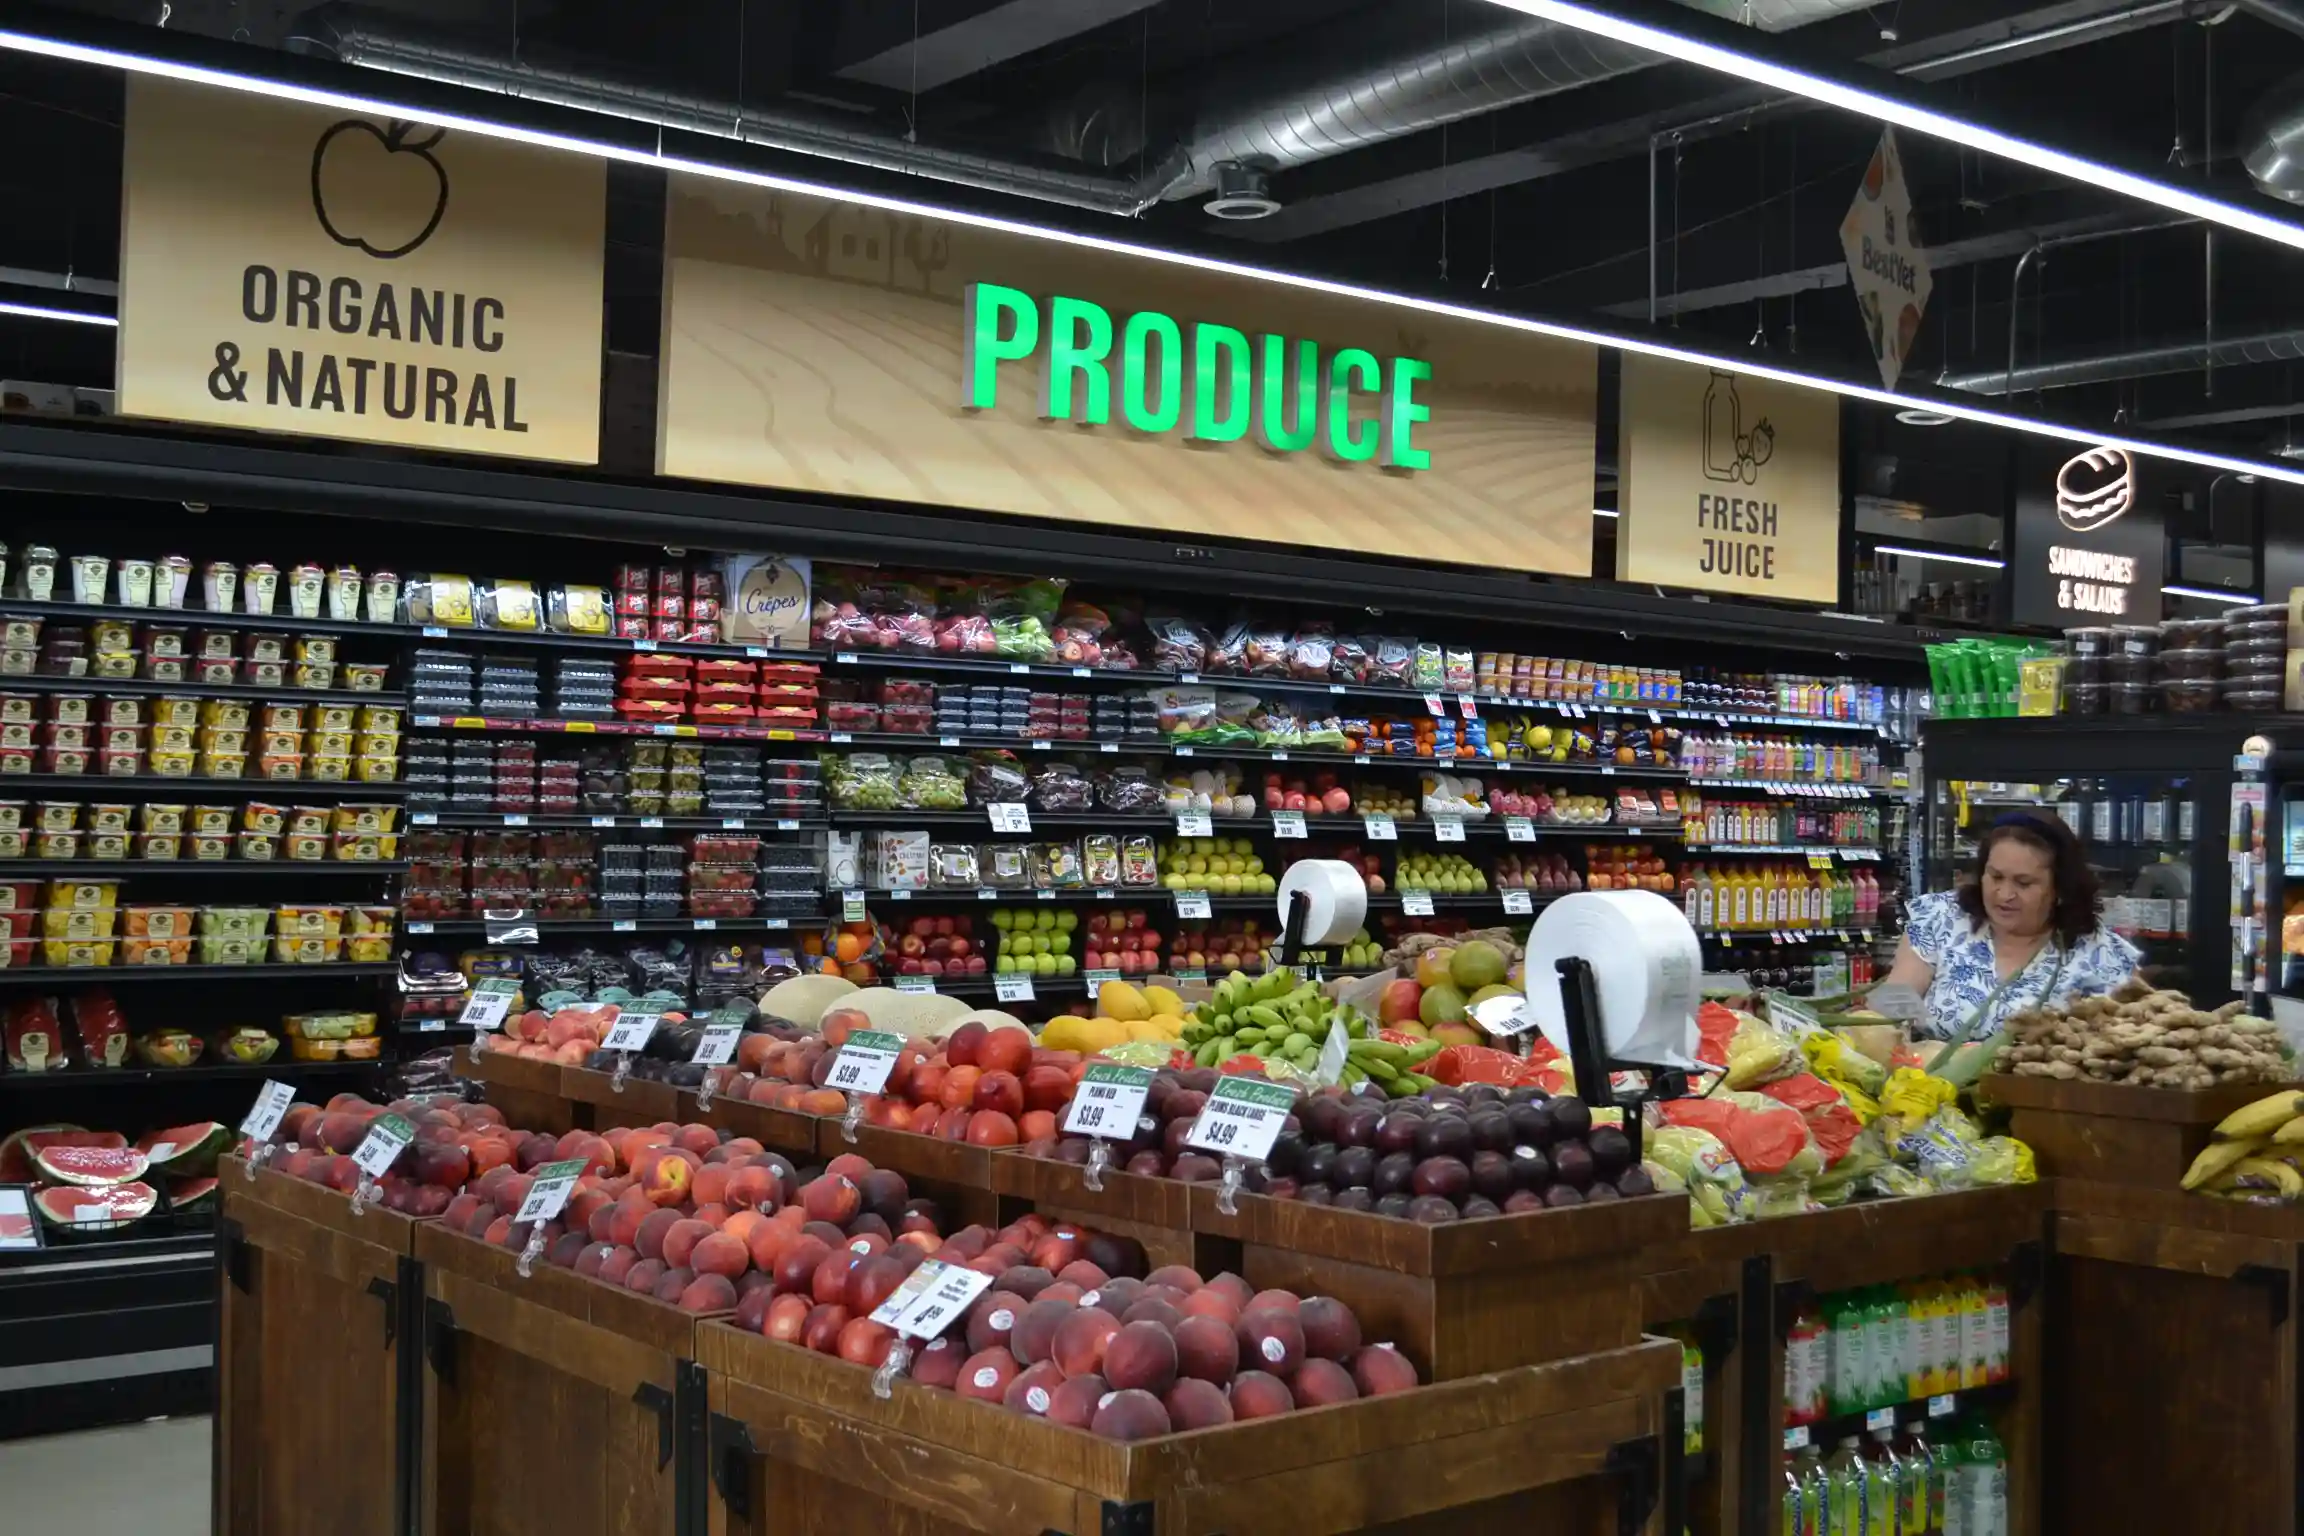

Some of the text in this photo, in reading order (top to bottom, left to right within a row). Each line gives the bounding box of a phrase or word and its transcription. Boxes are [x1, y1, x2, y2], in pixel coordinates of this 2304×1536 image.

[242, 264, 504, 353] ORGANIC
[207, 341, 529, 433] & NATURAL
[962, 282, 1432, 472] PRODUCE
[1698, 493, 1777, 537] FRESH
[1700, 538, 1775, 580] JUICE
[2048, 545, 2138, 584] SANDWICHES
[2057, 579, 2127, 615] & SALADS
[835, 1063, 861, 1084] $3.99
[1086, 1067, 1147, 1085] Fresh Produce
[1208, 1098, 1267, 1122] PLUMS BLACK LARGE
[1218, 1080, 1295, 1110] Fresh Produce
[1077, 1103, 1105, 1127] $3.99
[1204, 1120, 1238, 1146] $4.99
